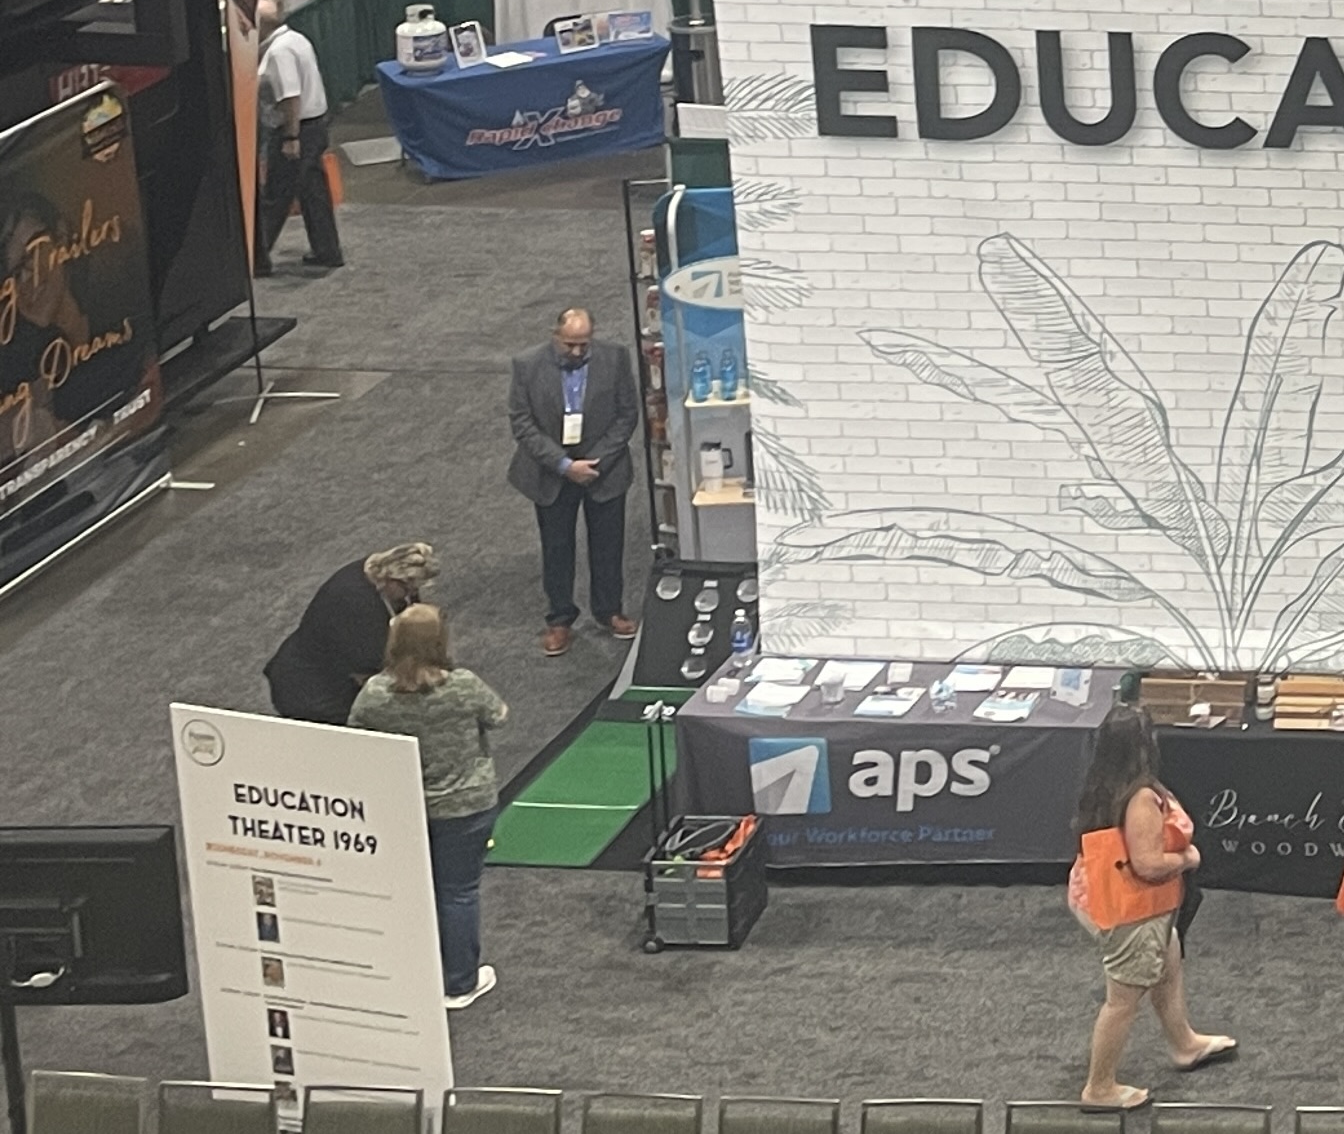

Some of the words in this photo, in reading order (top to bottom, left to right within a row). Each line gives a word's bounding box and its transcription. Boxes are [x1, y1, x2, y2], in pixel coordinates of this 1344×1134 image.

[27, 199, 121, 288] Trailers
[41, 316, 134, 390] Dreams
[112, 387, 152, 425] TRUST
[0, 424, 99, 501] TRANSPARENCY
[847, 745, 992, 812] aps
[233, 783, 366, 823] EDUCATION
[1209, 788, 1325, 833] Branch
[227, 815, 326, 849] THEATER
[333, 830, 378, 856] 1969
[766, 828, 800, 846] our
[805, 824, 913, 845] Workforce
[917, 823, 997, 843] Partner
